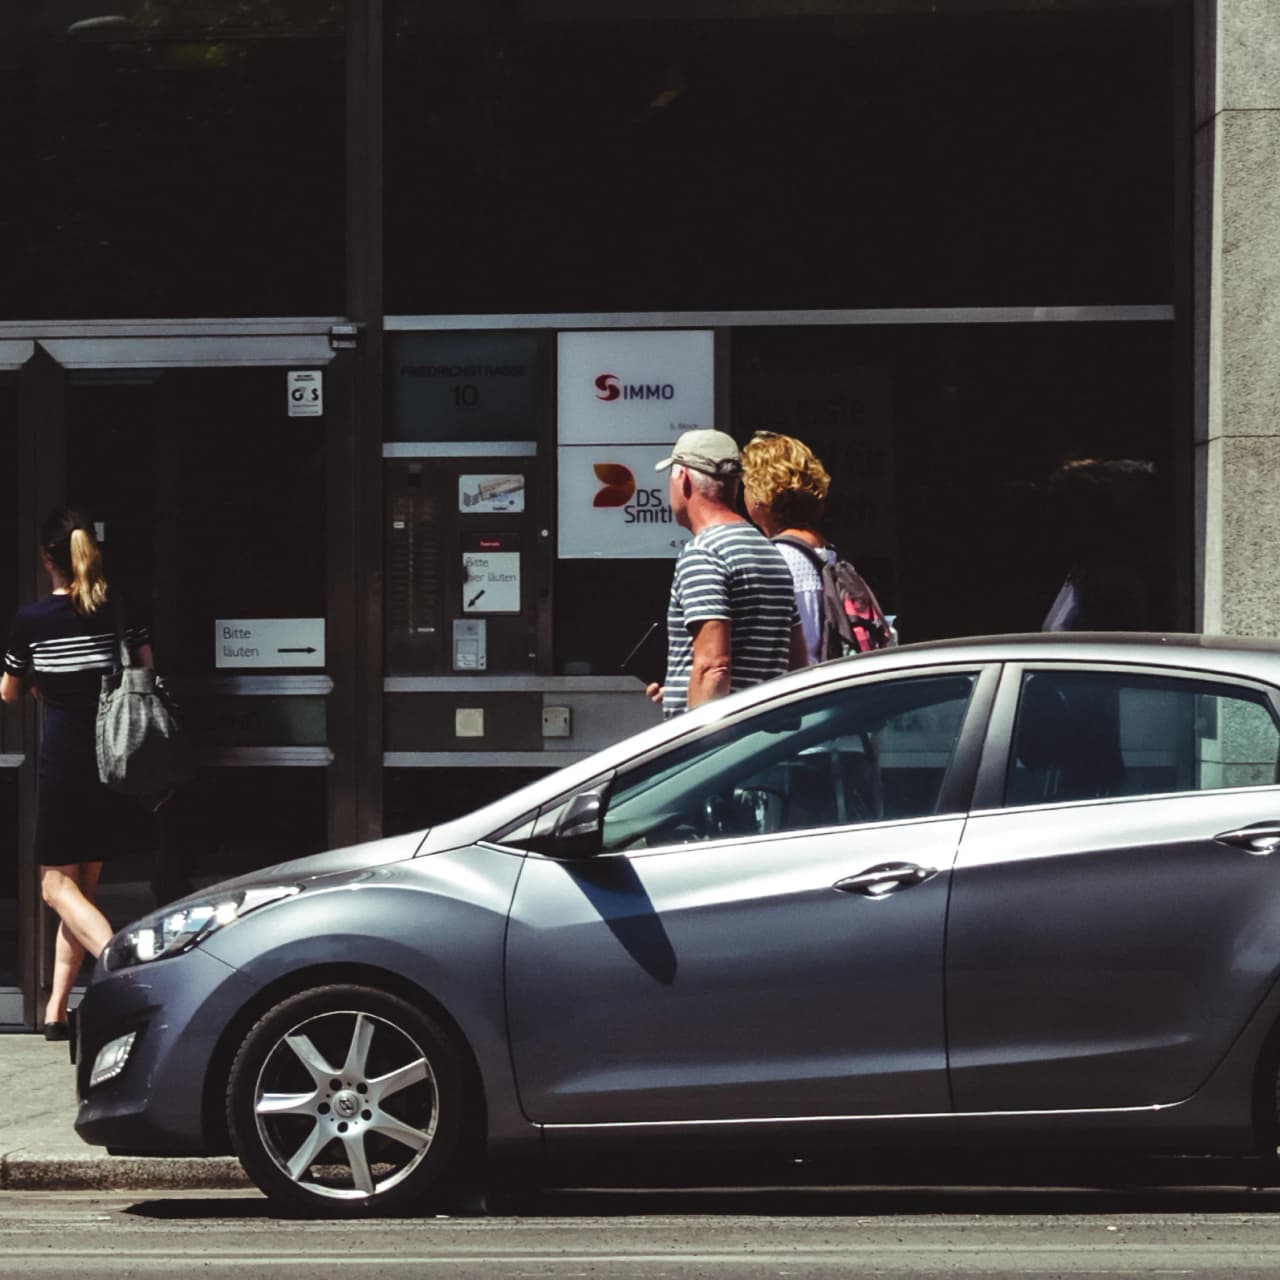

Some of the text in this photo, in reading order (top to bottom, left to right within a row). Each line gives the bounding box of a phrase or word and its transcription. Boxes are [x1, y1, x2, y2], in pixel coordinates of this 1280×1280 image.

[451, 383, 479, 407] 10
[636, 488, 662, 507] DS
[223, 626, 252, 640] Bitte
[223, 644, 260, 658] läuten
